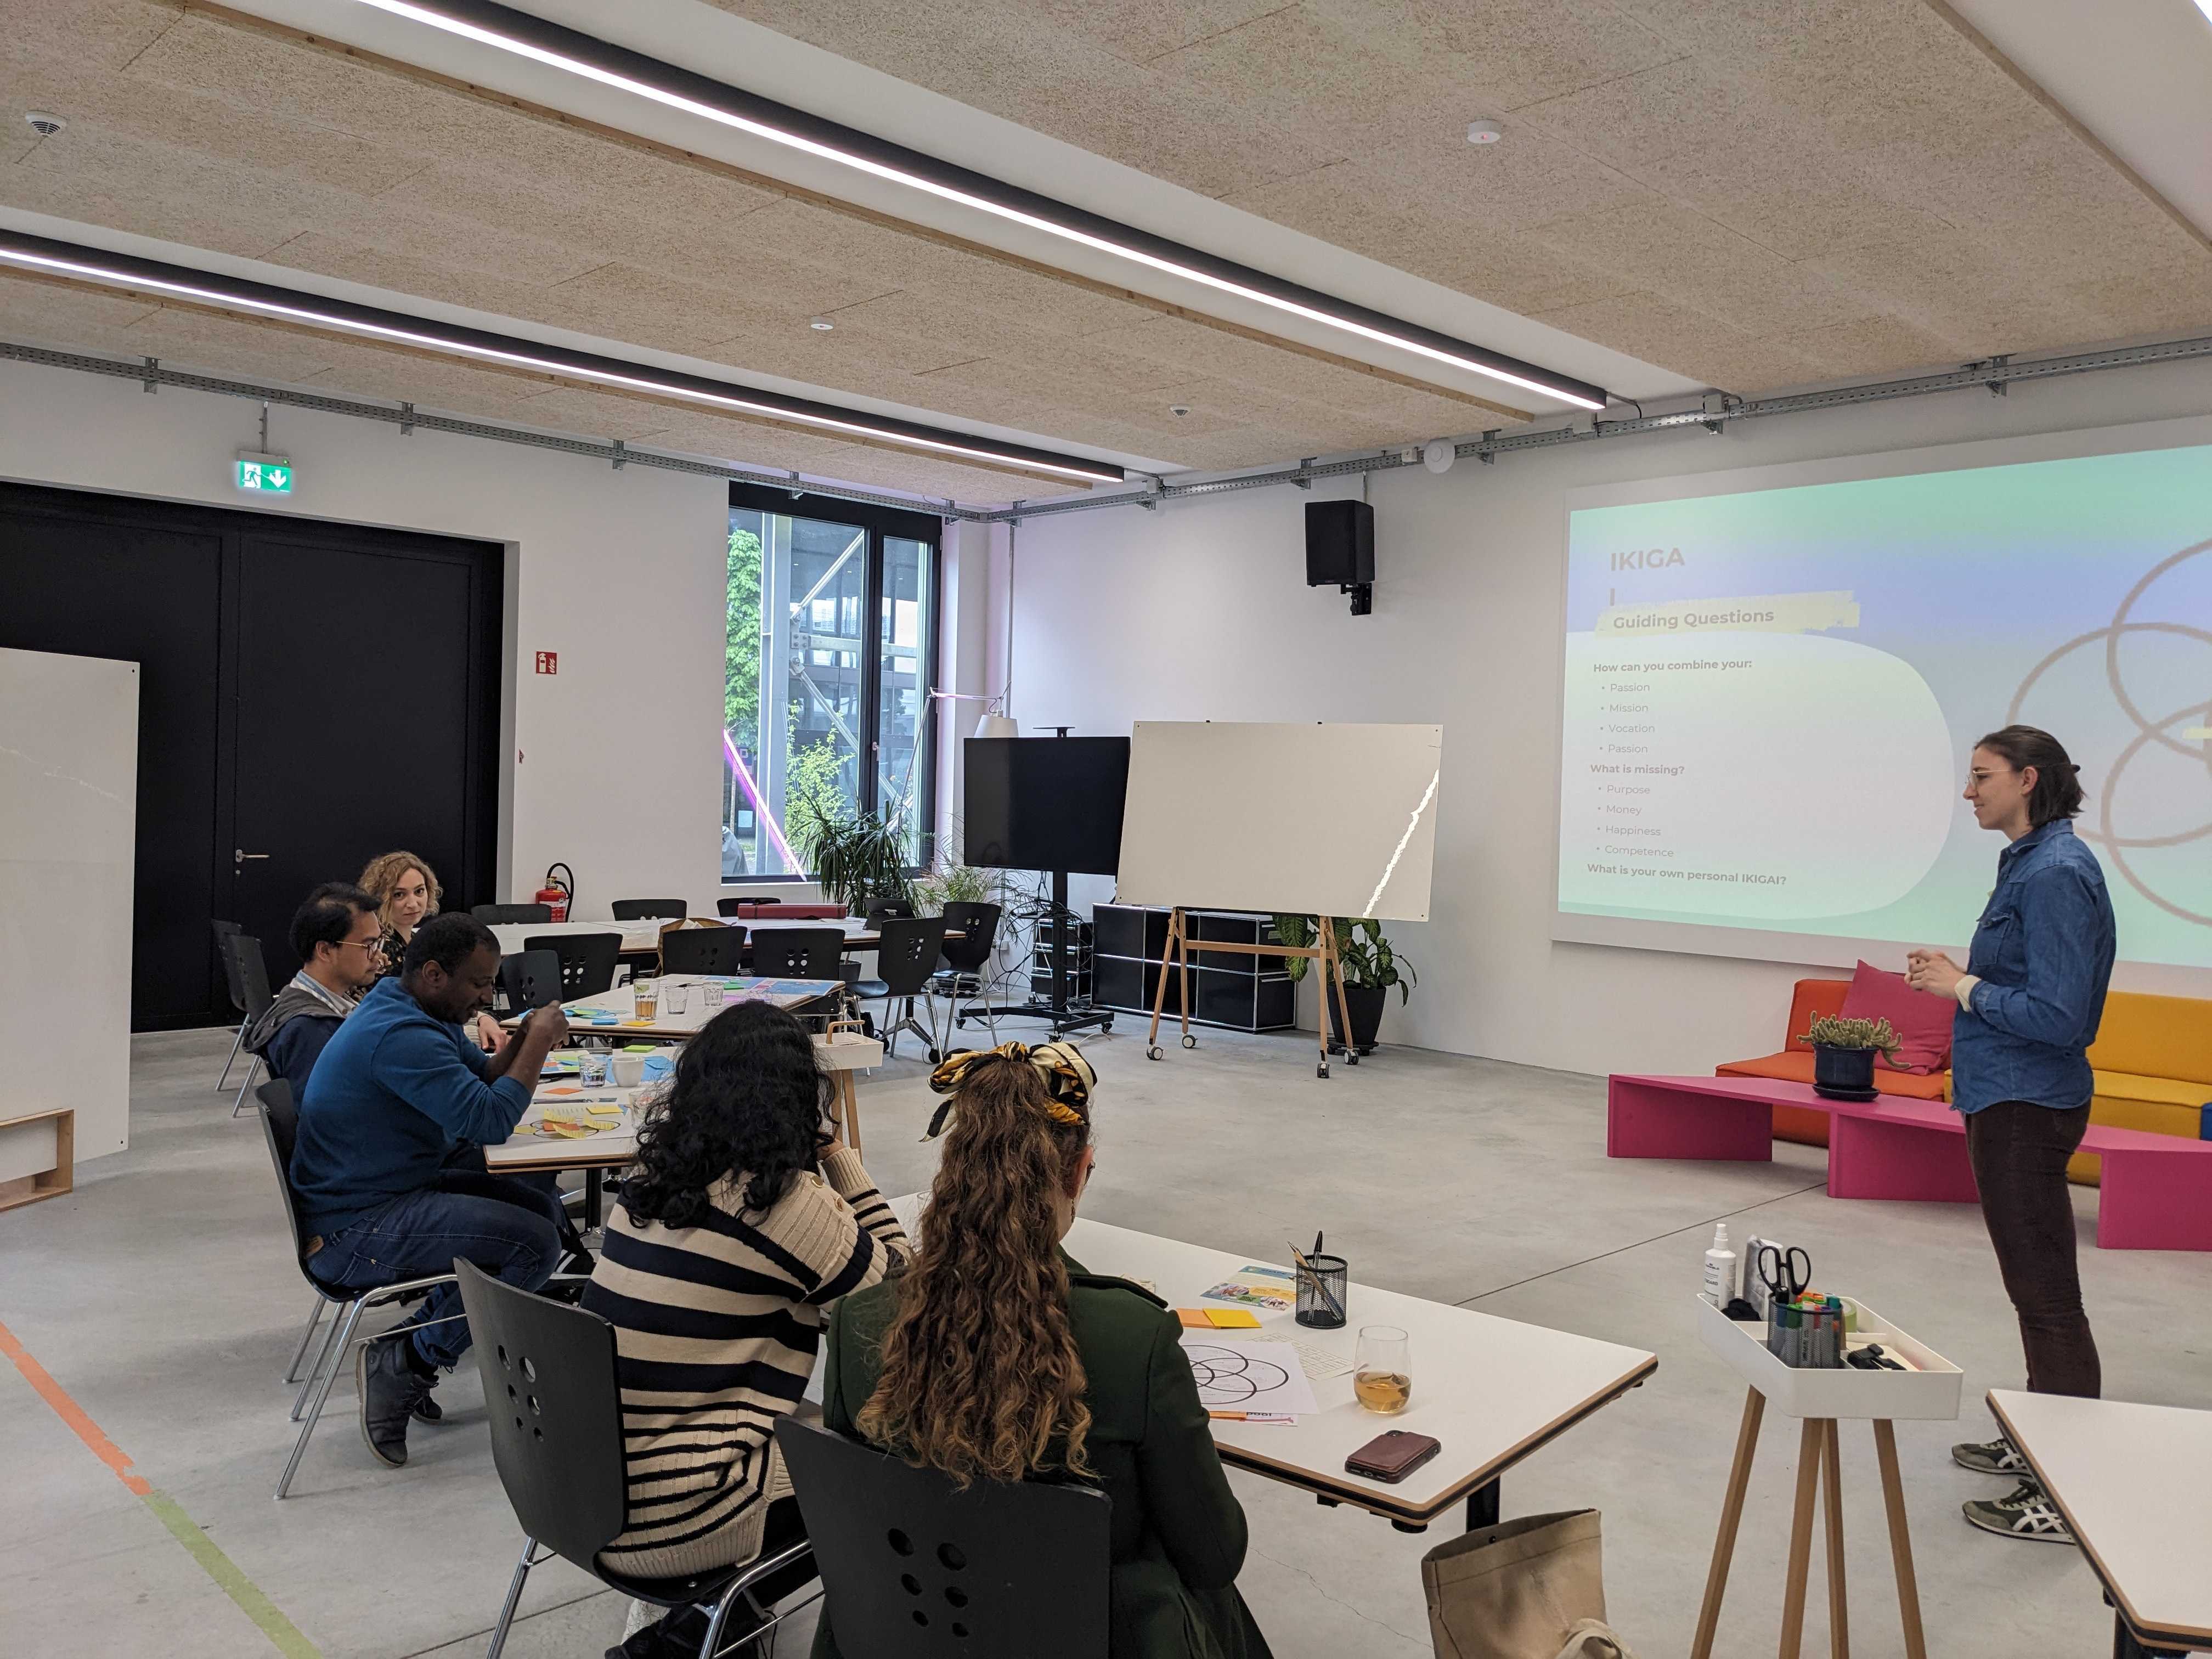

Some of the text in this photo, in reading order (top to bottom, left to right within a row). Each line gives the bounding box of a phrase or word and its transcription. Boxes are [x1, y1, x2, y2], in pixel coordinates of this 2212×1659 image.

[1611, 548, 1685, 571] IKIGA
[1613, 609, 1774, 629] Guiding Questions
[1594, 659, 1752, 673] How can you combine your:
[1610, 683, 1650, 692] Passion
[1610, 703, 1649, 713] Mission
[1609, 724, 1655, 733] Vocation
[1608, 744, 1648, 753] Passion
[1591, 764, 1685, 776] What is missing?
[1607, 785, 1650, 795] Purpose
[1606, 805, 1642, 816] Money
[1606, 825, 1661, 836] Happiness
[1605, 845, 1674, 857] Competence
[1588, 864, 1787, 885] What is your own personal IKIGAI?
